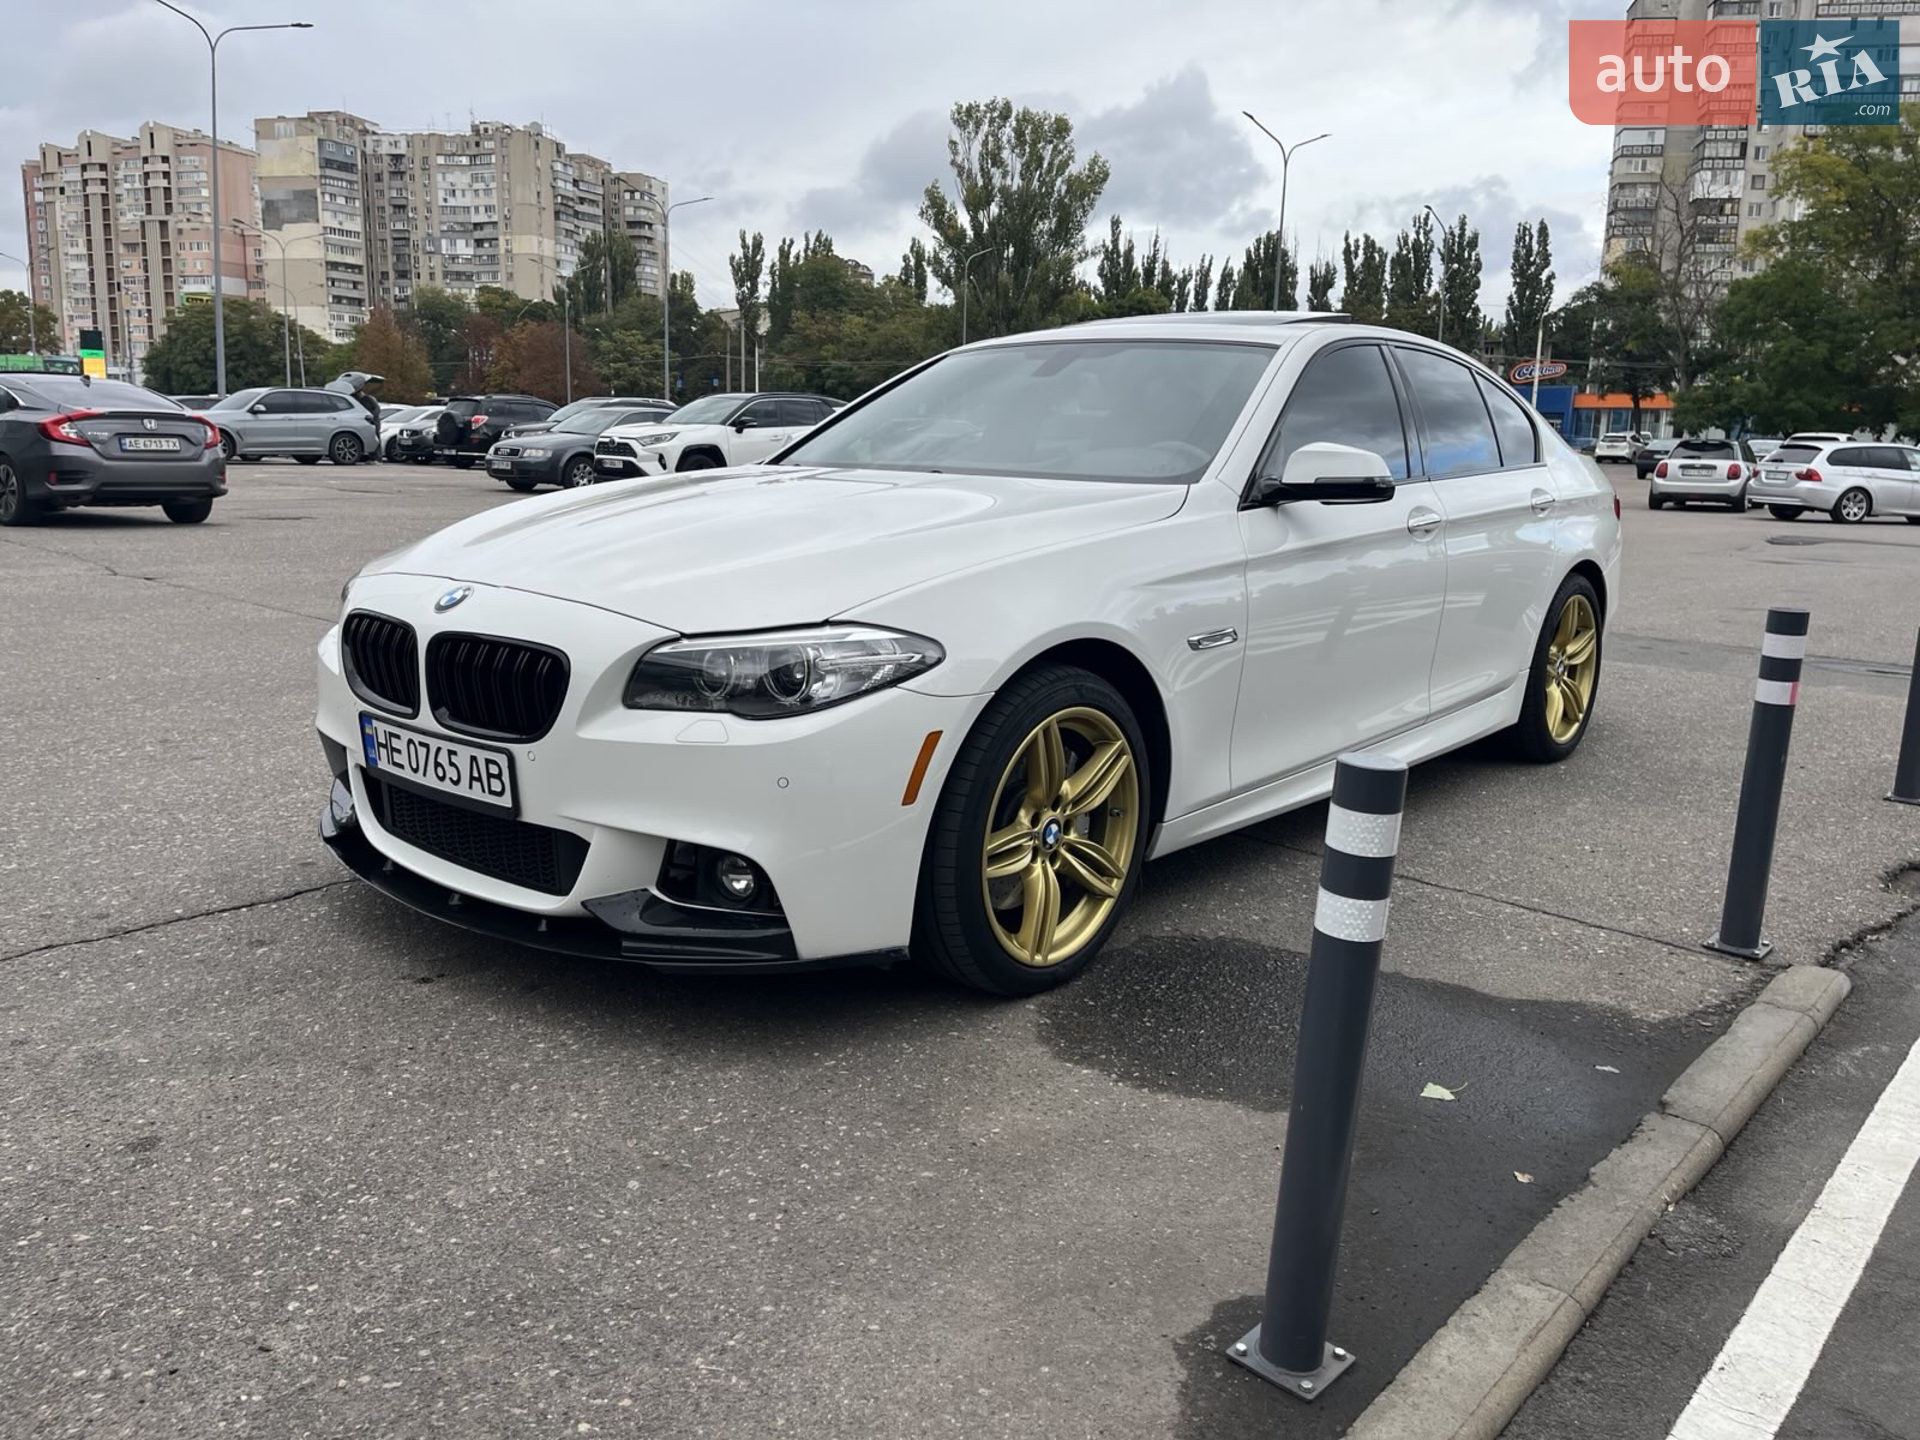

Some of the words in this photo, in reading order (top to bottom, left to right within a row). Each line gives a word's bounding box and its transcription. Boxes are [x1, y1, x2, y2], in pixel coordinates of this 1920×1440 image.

[128, 440, 142, 450] AE
[374, 726, 405, 771] HE
[406, 737, 462, 787] 0765
[468, 754, 506, 798] AB
